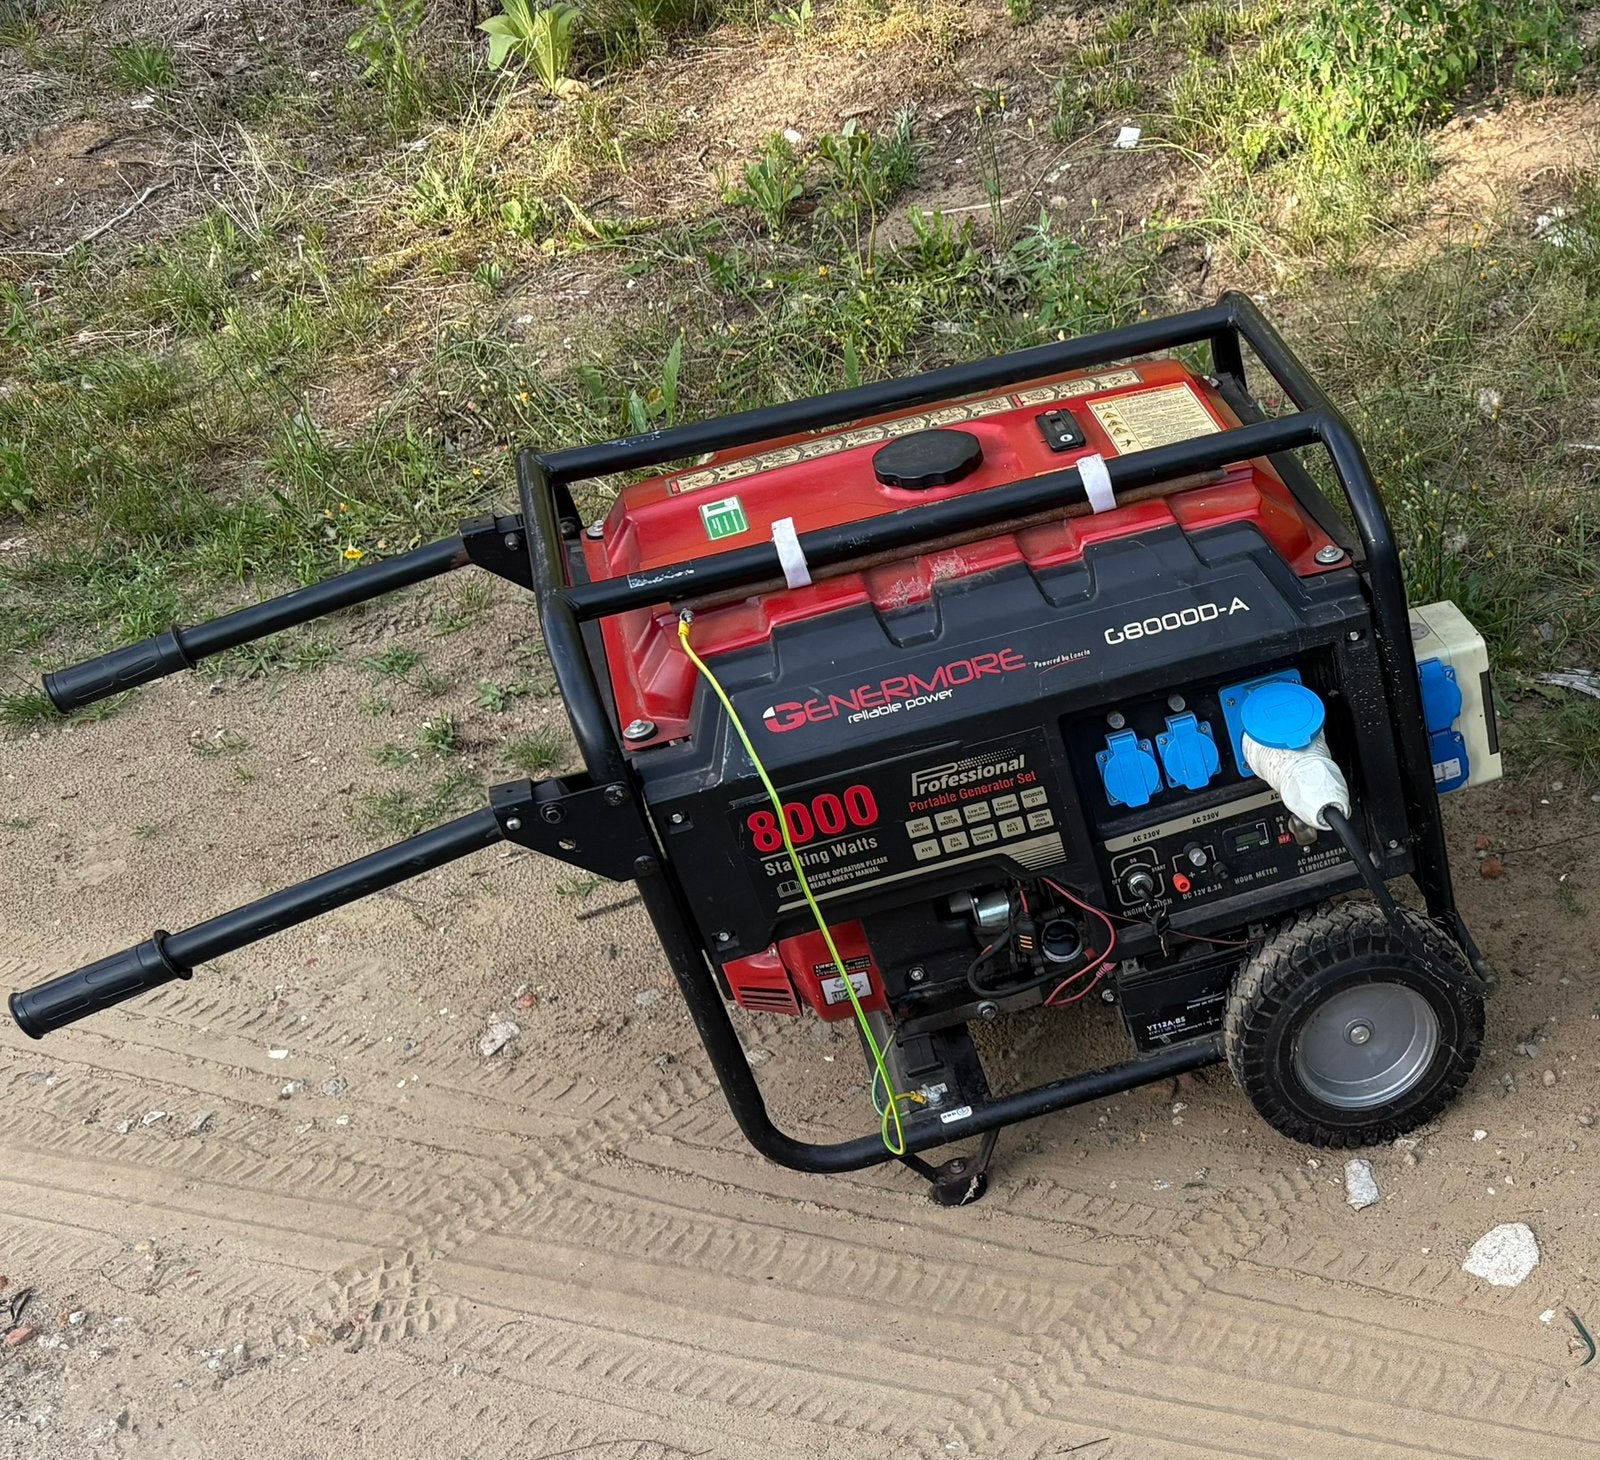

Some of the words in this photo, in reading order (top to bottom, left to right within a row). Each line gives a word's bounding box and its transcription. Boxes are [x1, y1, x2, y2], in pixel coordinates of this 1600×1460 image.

[1104, 597, 1250, 645] G8000D-A
[762, 648, 1026, 733] GENERMORE
[848, 702, 902, 725] reliable
[905, 688, 954, 711] power
[911, 754, 1025, 797] Professional
[908, 792, 958, 813] Portable
[959, 778, 1015, 800] Generator
[1016, 770, 1037, 785] Set
[1270, 793, 1279, 801] AC
[747, 784, 879, 852] 8000
[1192, 817, 1202, 825] AC
[1202, 811, 1220, 821] 230V
[1132, 835, 1142, 843] AC
[1143, 829, 1161, 840] 230V
[764, 850, 830, 876] Stating
[831, 837, 878, 858] Watts
[1151, 864, 1166, 873] START
[1297, 858, 1307, 866] AC
[1307, 851, 1324, 863] MAIN
[1305, 857, 1340, 873] INDICATOR
[807, 871, 831, 883] BEFORE
[832, 862, 865, 876] OPERATION
[865, 856, 889, 868] PLEASE
[809, 880, 827, 890] READ
[827, 873, 855, 886] OWNER'S
[855, 866, 880, 878] MANUAL
[1234, 874, 1254, 885] HOUR
[1255, 866, 1279, 879] METER
[1182, 891, 1192, 900] DC
[1194, 887, 1207, 896] 12V
[1207, 883, 1223, 893] 8.3A
